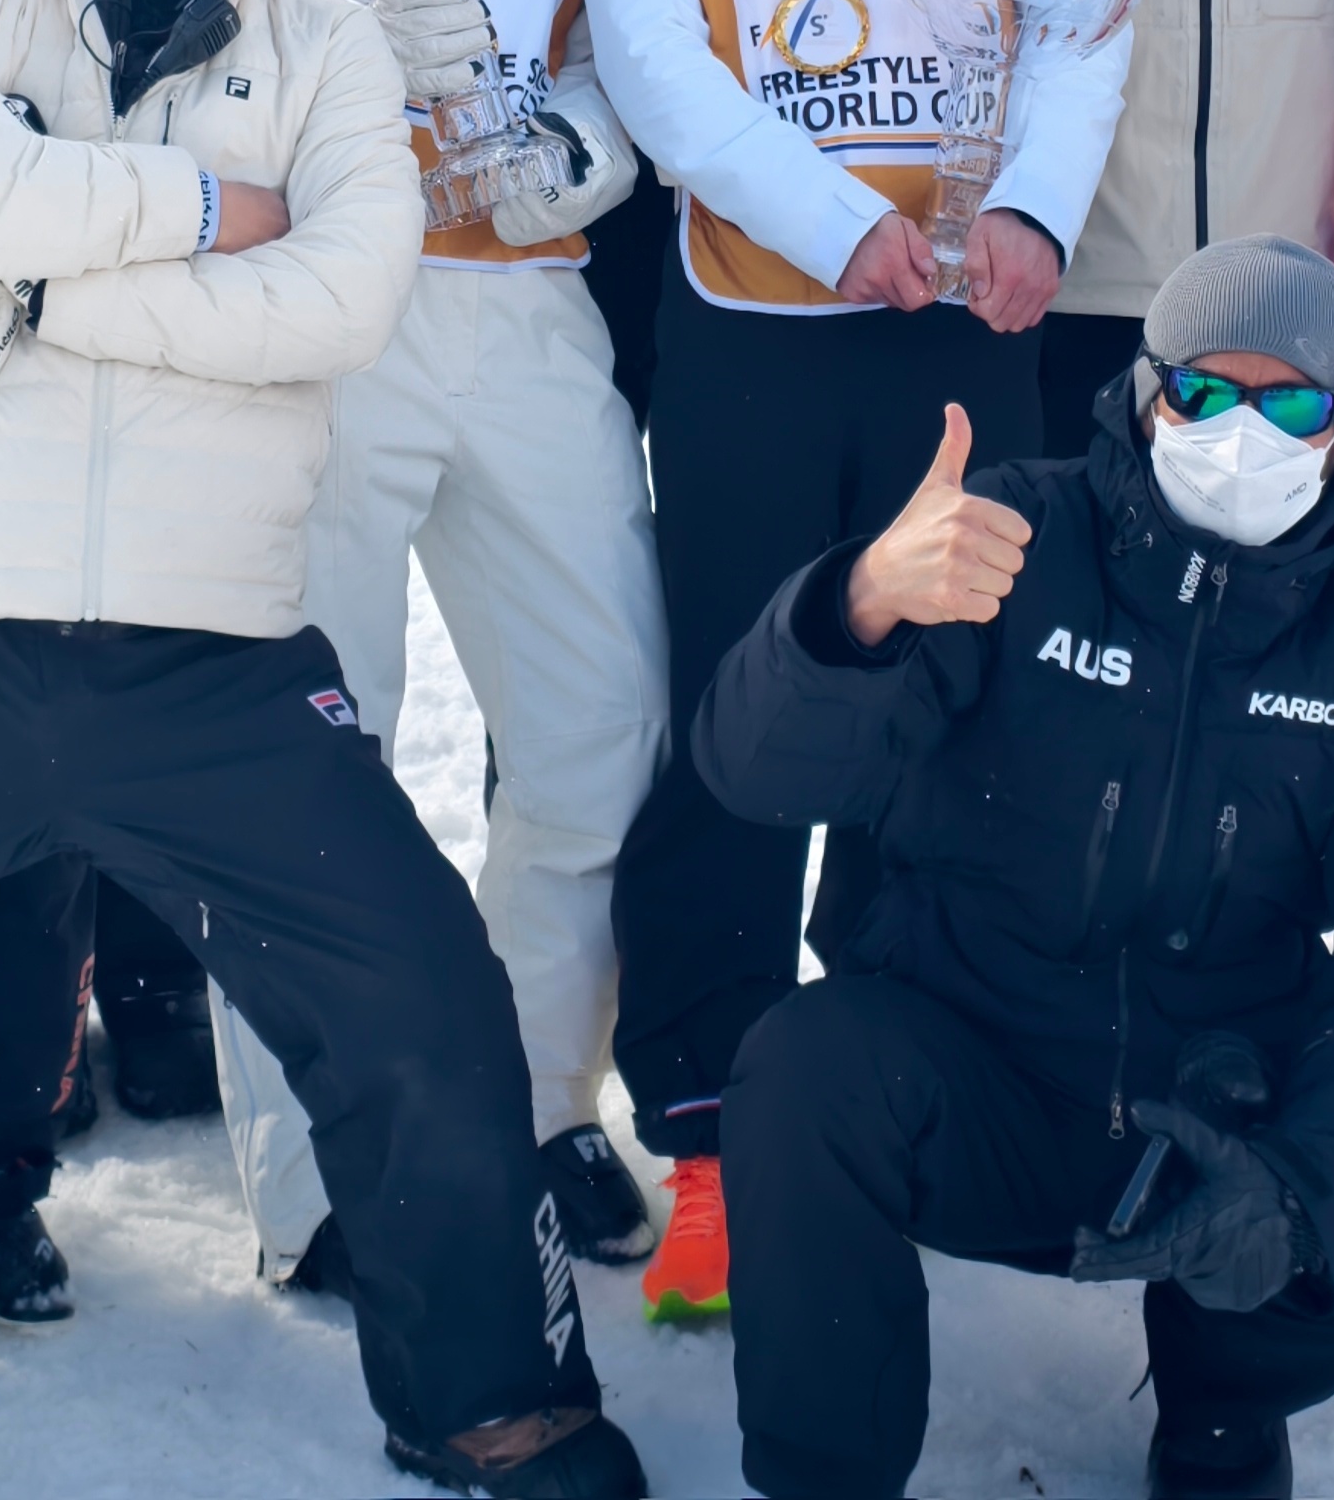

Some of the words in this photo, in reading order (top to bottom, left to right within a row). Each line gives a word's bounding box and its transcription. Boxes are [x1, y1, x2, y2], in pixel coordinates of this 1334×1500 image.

[760, 55, 941, 102] FREESTYLE
[1178, 550, 1208, 605] KARBON
[1036, 627, 1133, 687] AUS
[533, 1191, 575, 1370] CHINA
